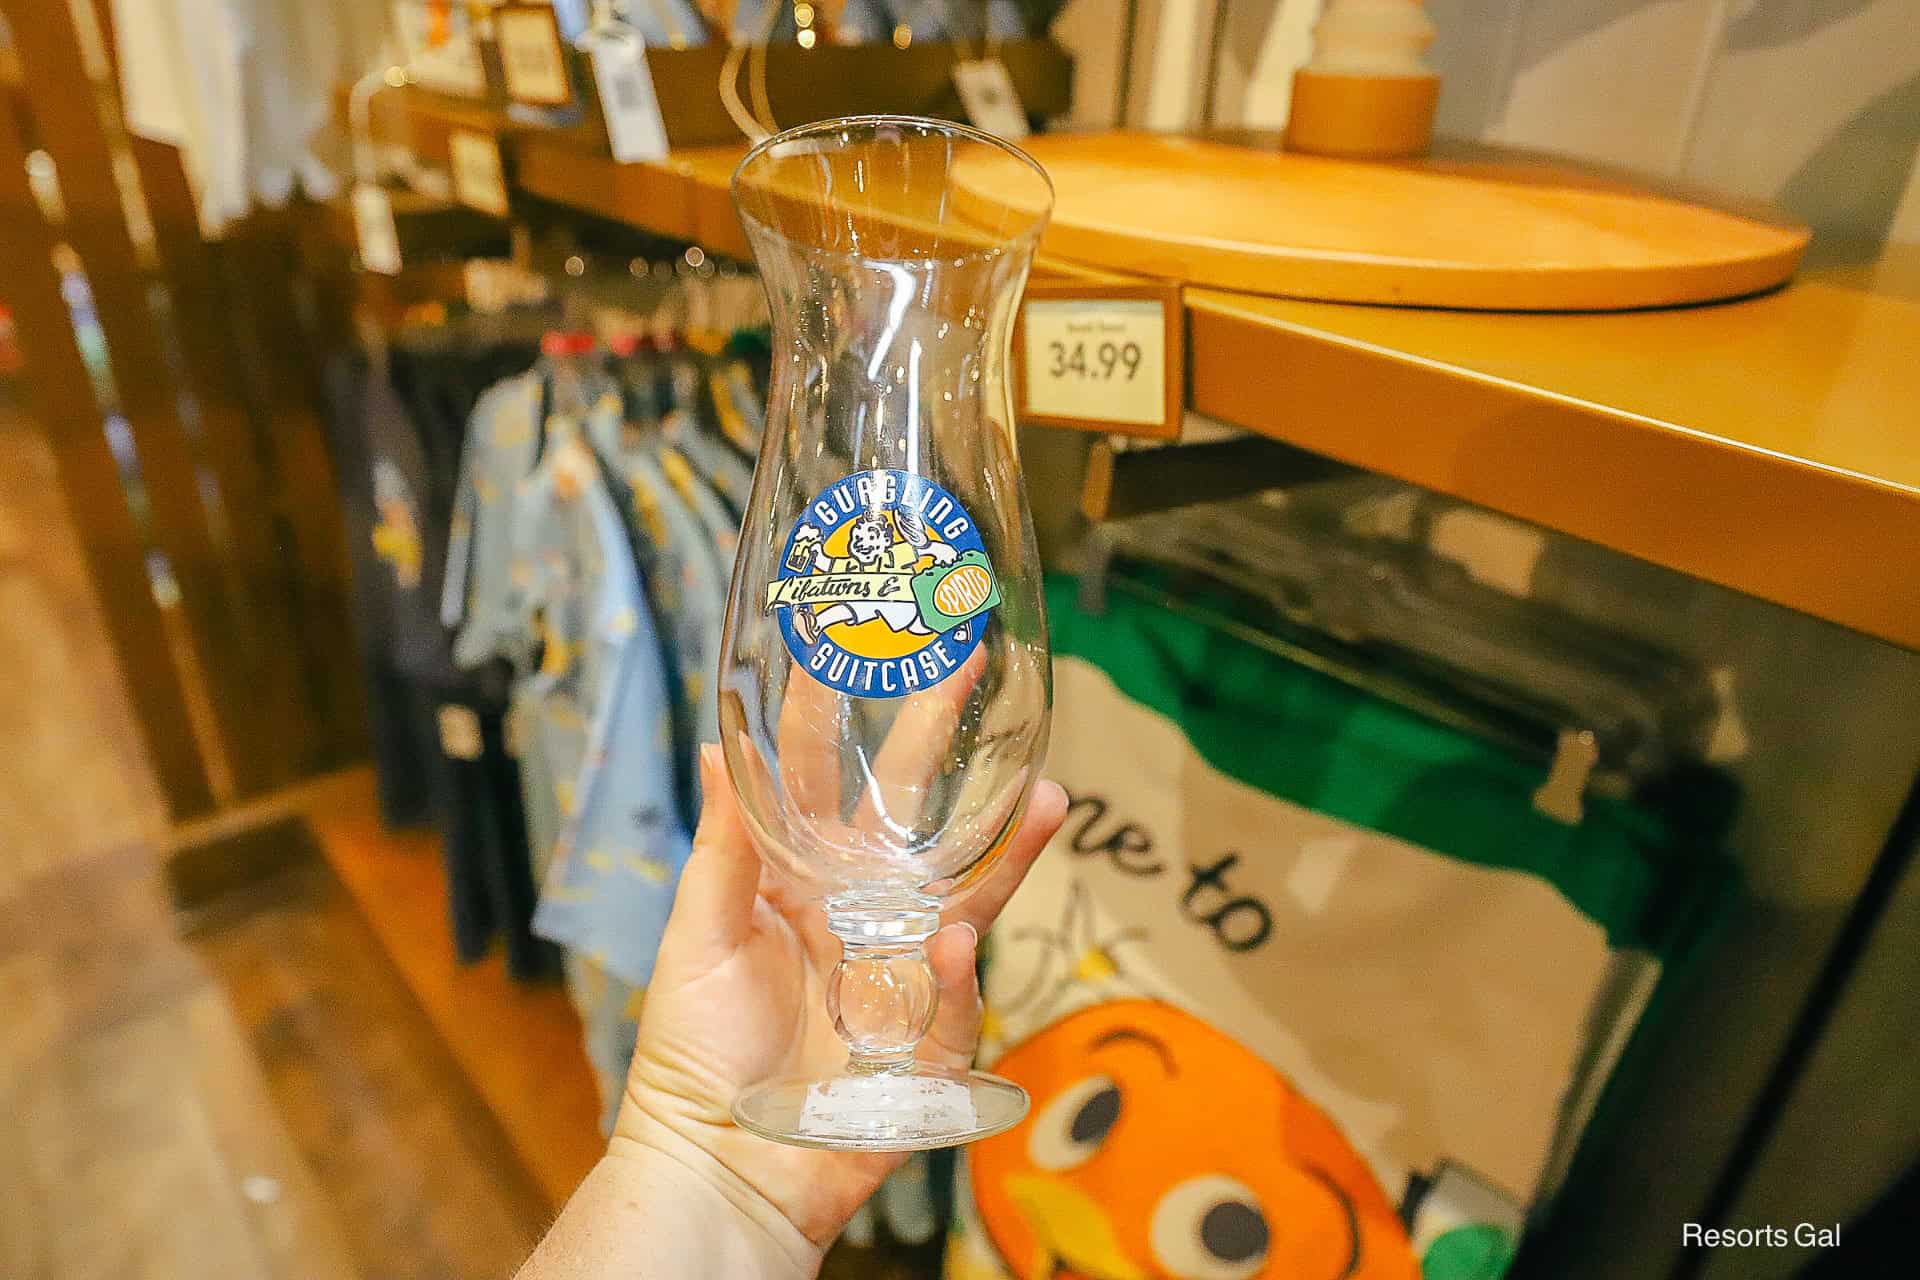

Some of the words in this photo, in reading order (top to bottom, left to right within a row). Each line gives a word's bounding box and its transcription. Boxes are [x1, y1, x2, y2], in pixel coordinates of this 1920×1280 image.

[1049, 341, 1141, 380] 34.99
[939, 568, 988, 613] SPIRITS
[810, 640, 956, 691] SUITCASE
[1180, 853, 1272, 952] to
